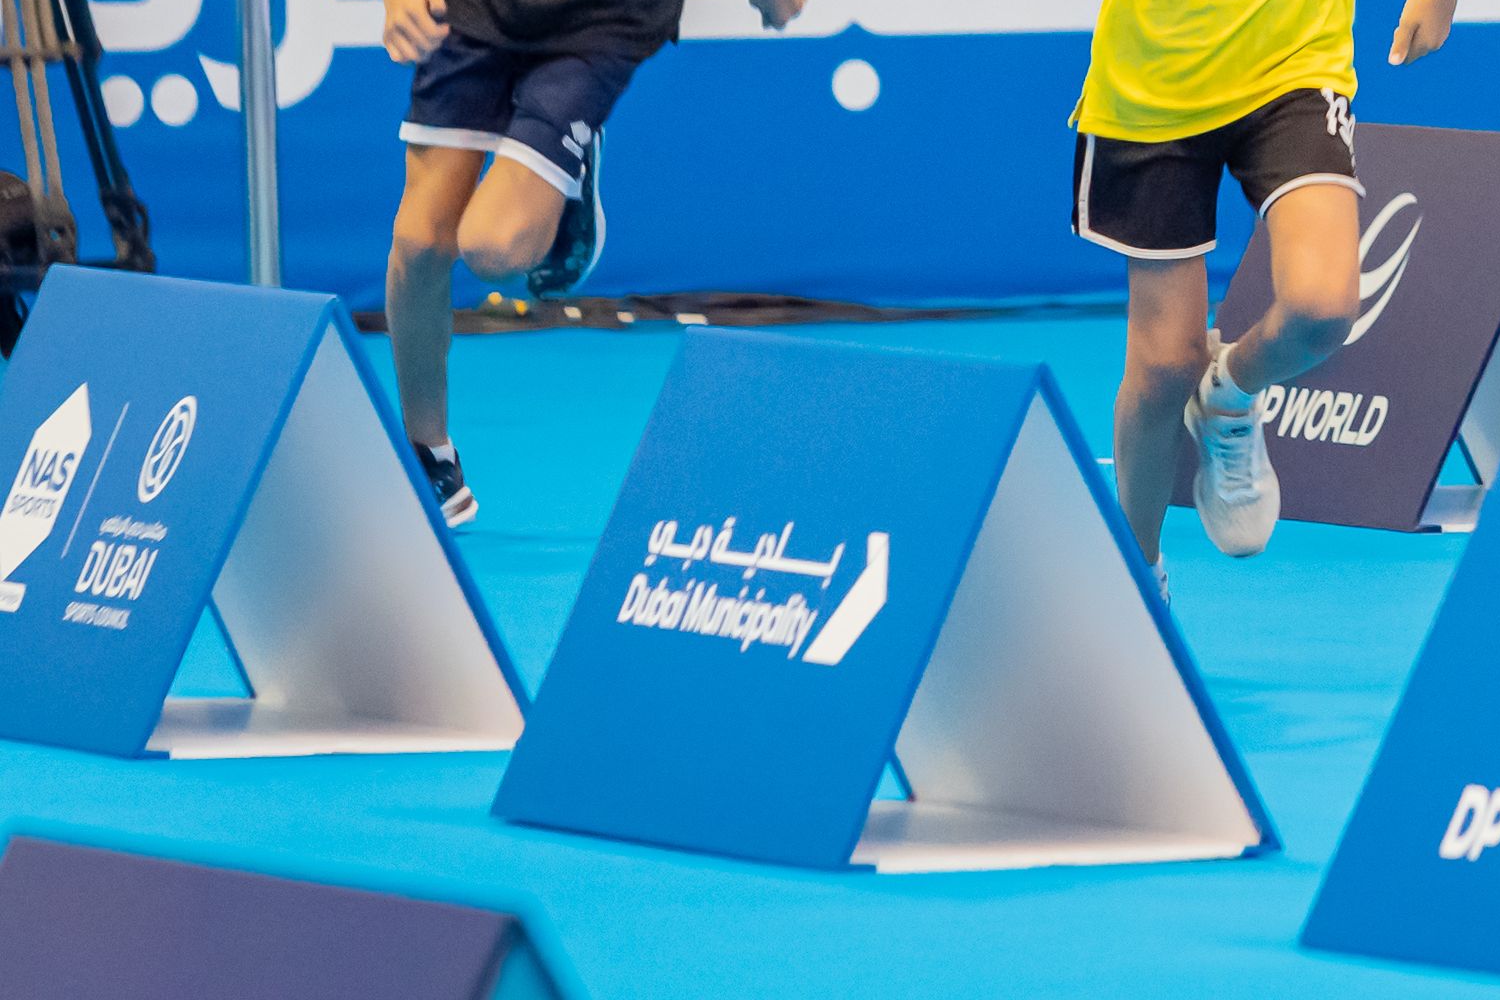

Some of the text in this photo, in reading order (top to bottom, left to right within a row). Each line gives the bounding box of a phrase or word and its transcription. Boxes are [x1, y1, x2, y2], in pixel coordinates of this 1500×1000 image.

[1277, 387, 1389, 447] WORLD
[19, 447, 77, 493] NAS
[7, 493, 58, 519] SPORTS
[74, 540, 160, 601] DUBAI
[643, 514, 847, 589] بلدية دبي
[616, 572, 821, 660] Dubai Municipality
